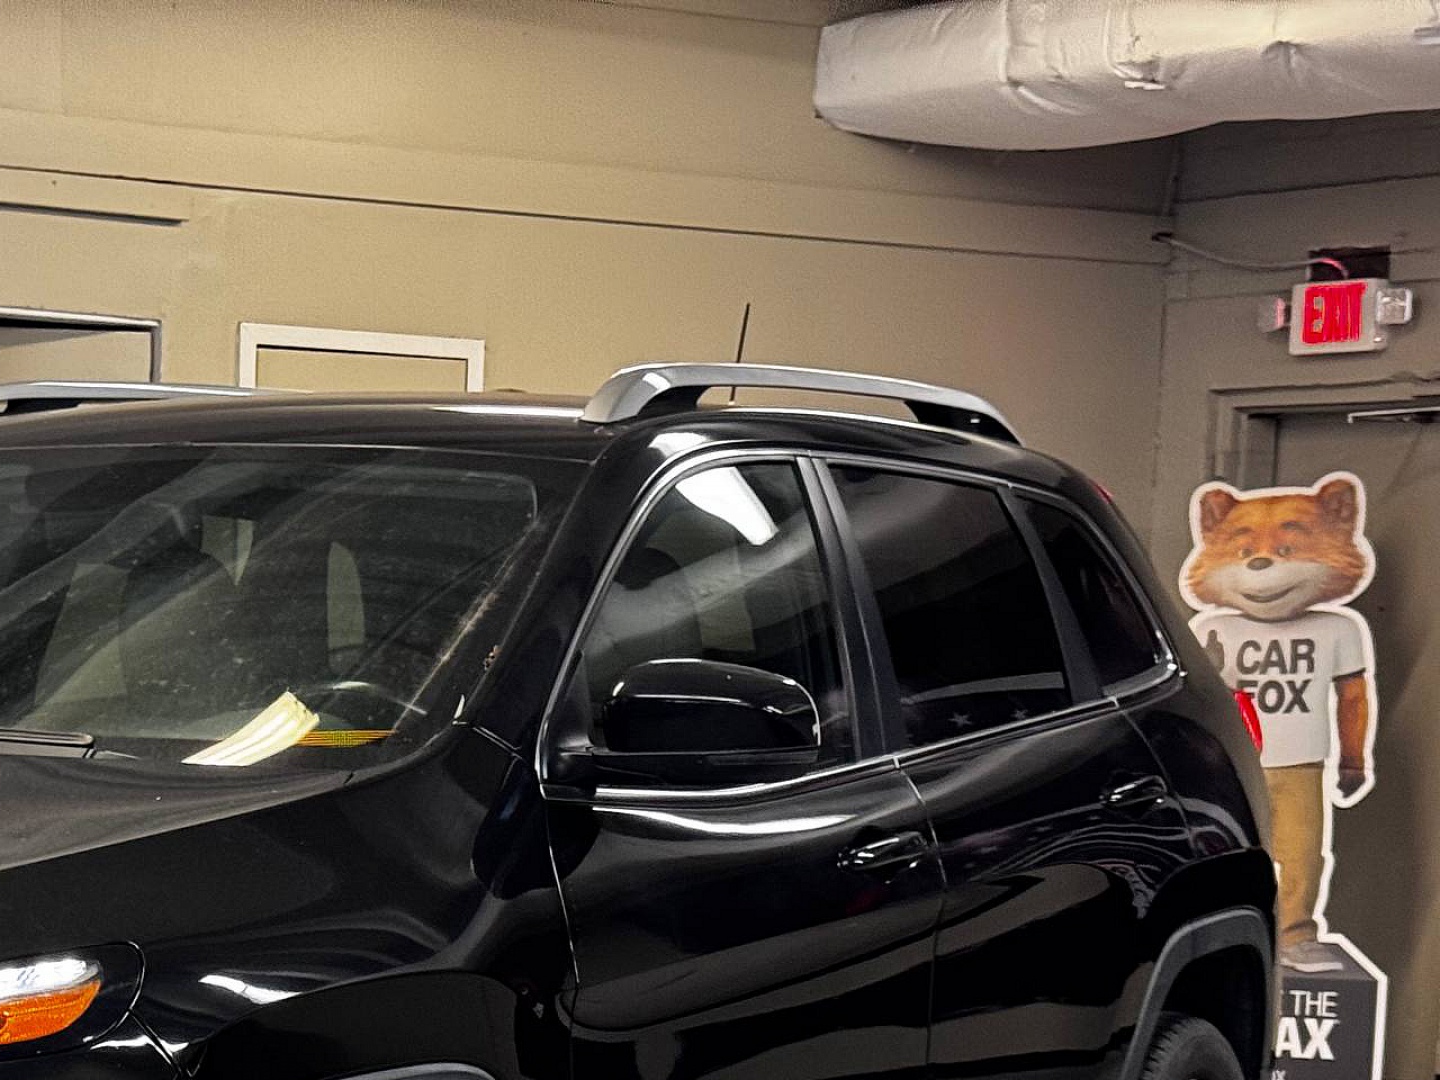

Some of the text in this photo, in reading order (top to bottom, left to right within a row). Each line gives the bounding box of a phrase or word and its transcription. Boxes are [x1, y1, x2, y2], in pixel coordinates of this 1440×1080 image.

[1303, 283, 1366, 343] EXIT
[1236, 638, 1316, 675] CAR
[1289, 989, 1340, 1018] THE
